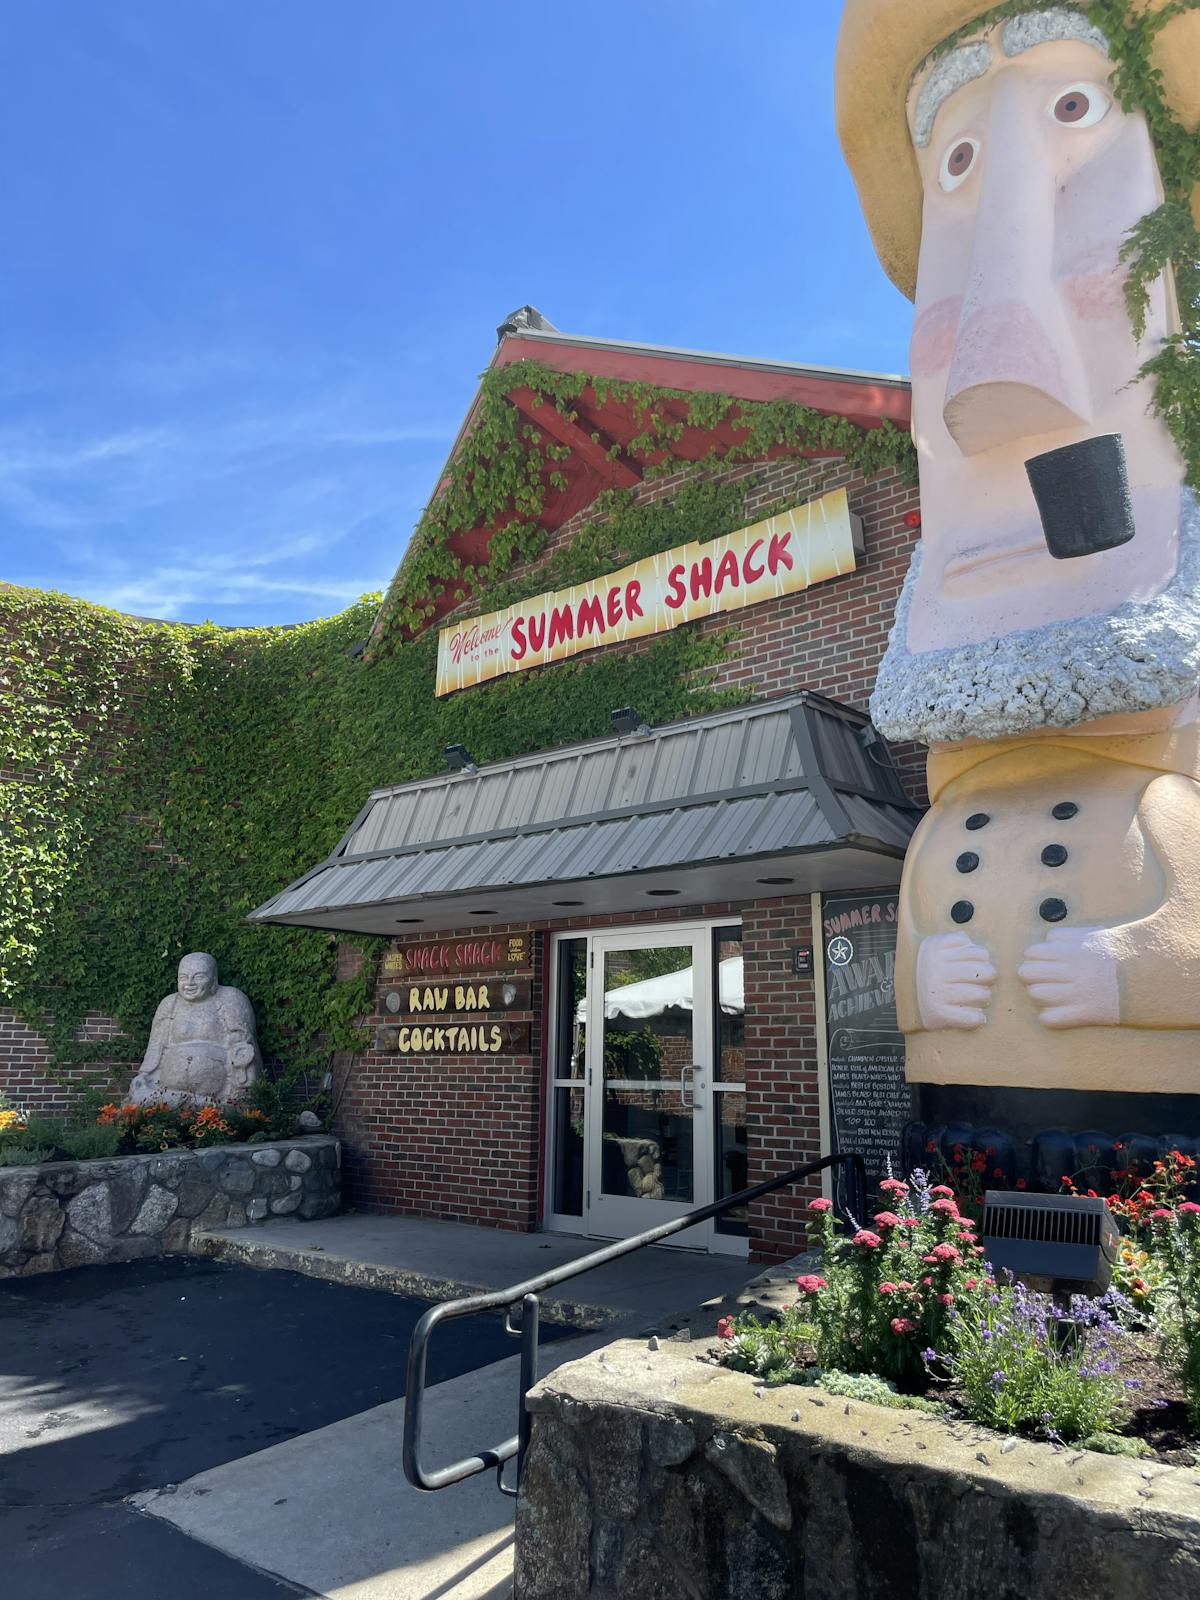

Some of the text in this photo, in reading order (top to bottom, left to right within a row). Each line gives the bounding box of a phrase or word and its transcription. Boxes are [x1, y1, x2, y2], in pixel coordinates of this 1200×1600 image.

[511, 531, 793, 661] SUMMER SHACK
[450, 617, 513, 664] Welcome
[471, 647, 499, 662] to the
[824, 903, 881, 938] SUMMER
[508, 938, 523, 947] FOOD
[507, 952, 525, 962] LOVE
[409, 985, 491, 1013] RAW BAR
[398, 1025, 502, 1053] COCKTAILS
